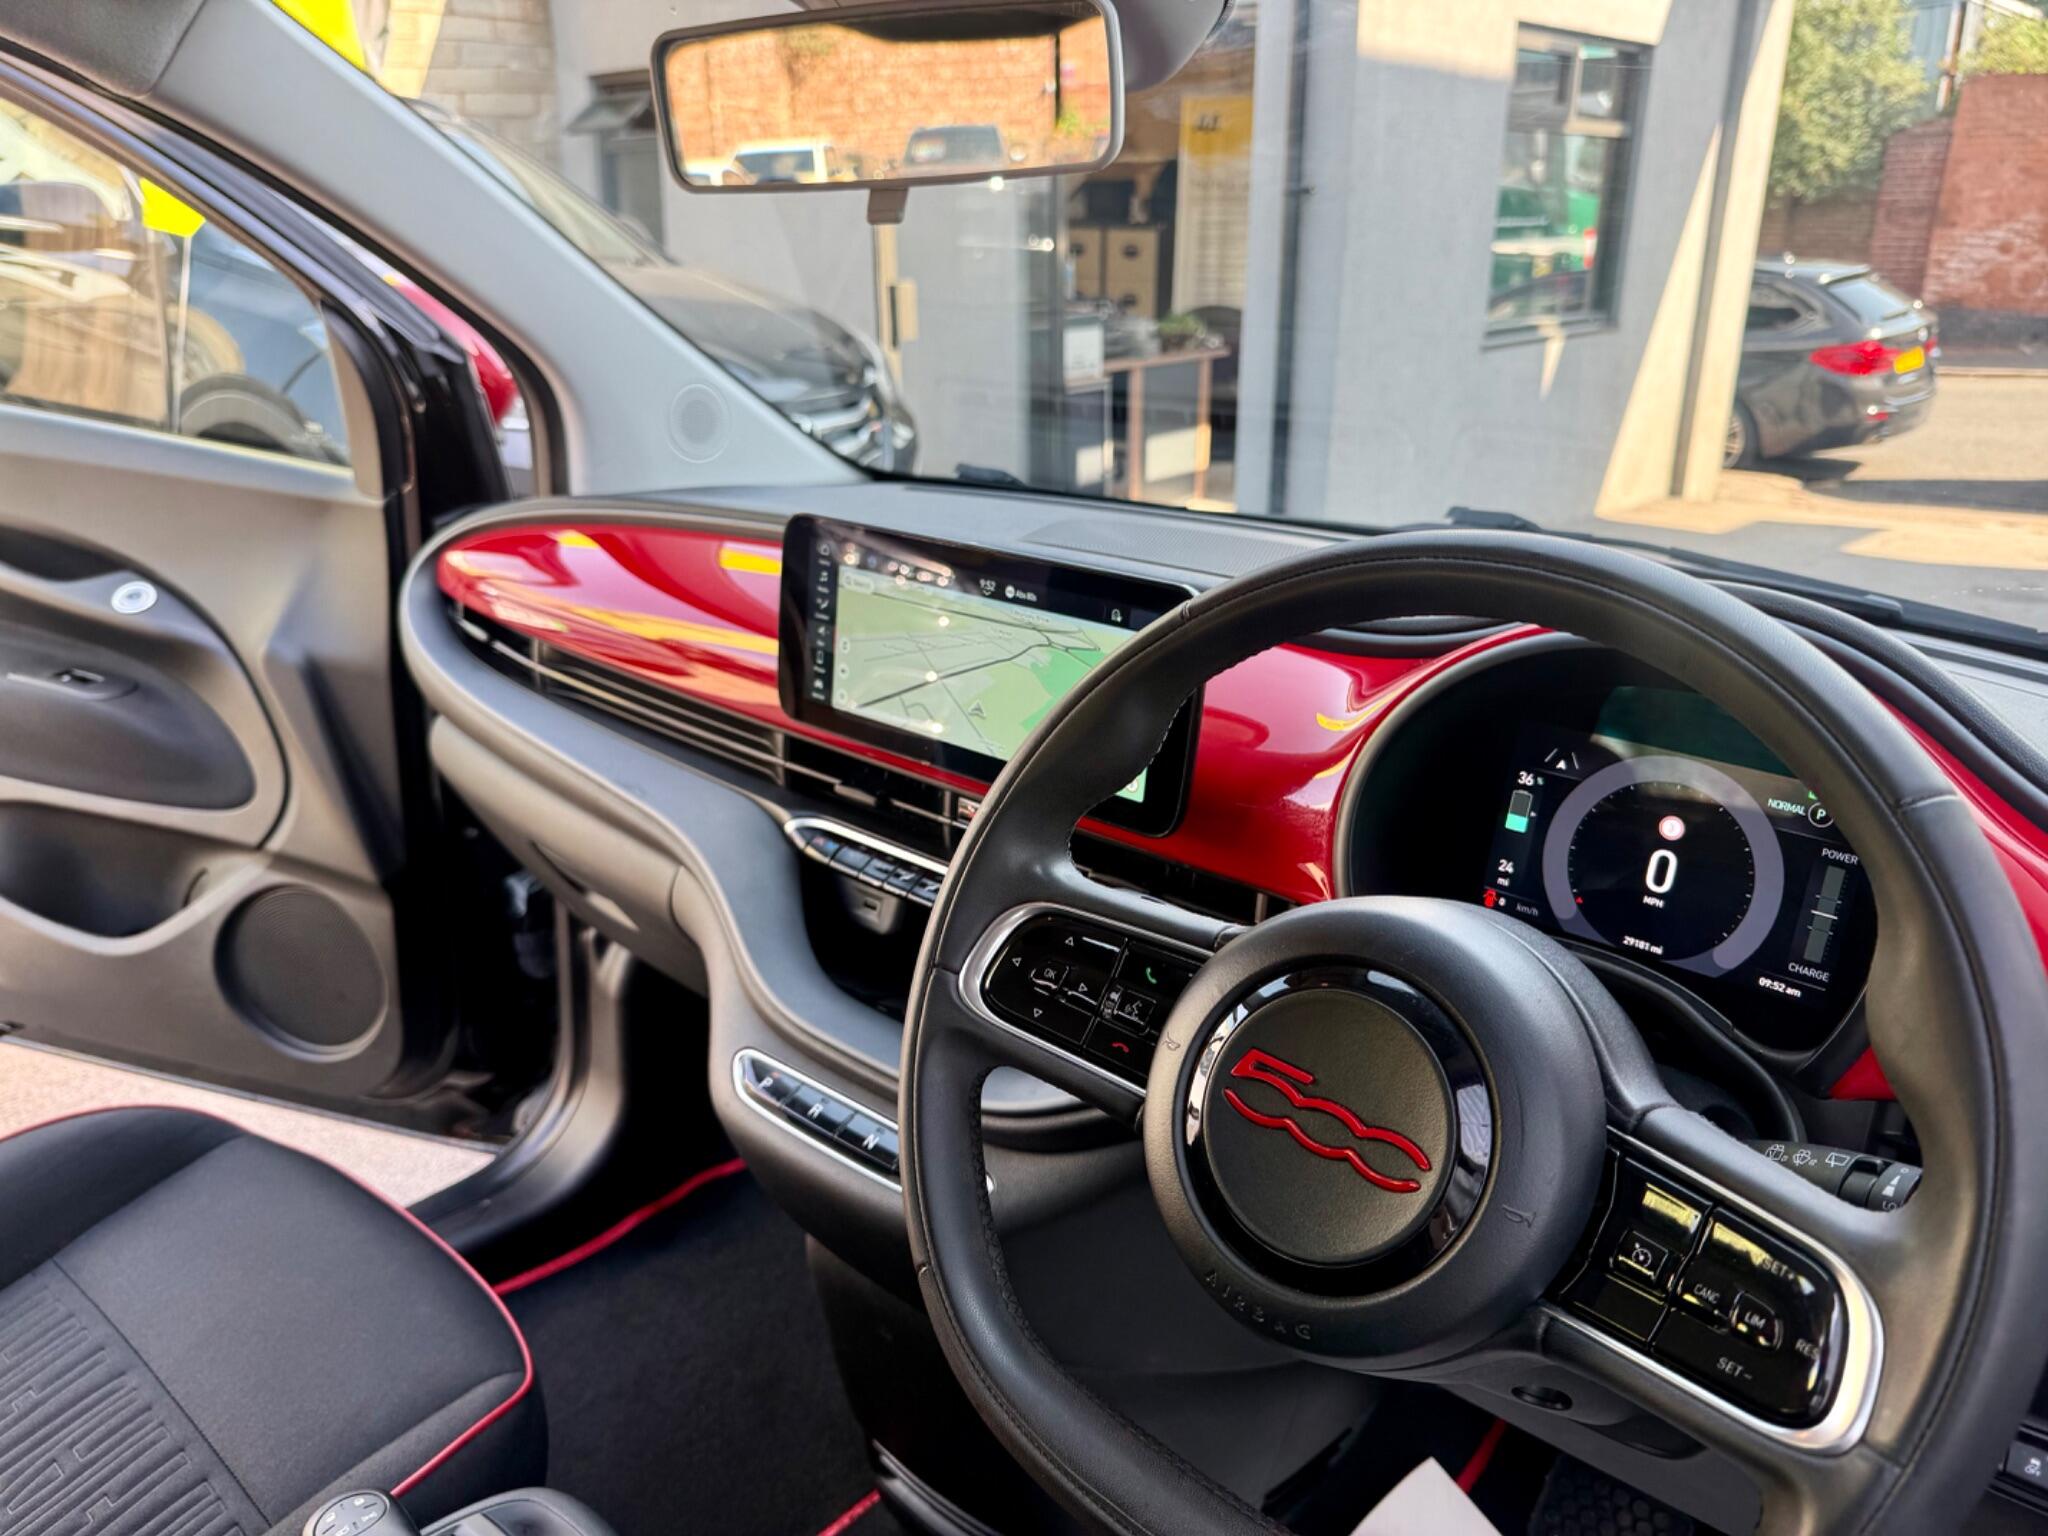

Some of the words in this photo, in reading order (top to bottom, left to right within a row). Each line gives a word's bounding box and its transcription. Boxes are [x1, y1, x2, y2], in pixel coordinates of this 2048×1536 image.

[1517, 770, 1534, 786] 36
[1767, 798, 1806, 816] NORMAL
[1816, 808, 1826, 820] P
[1821, 847, 1859, 865] POWER
[1498, 858, 1514, 874] 24
[1645, 848, 1678, 894] 0
[1642, 895, 1665, 909] MPH
[1787, 962, 1830, 983] CHARGE
[1758, 976, 1786, 993] 09:52
[1785, 986, 1802, 998] am
[757, 1077, 774, 1090] P
[806, 1103, 824, 1120] R
[1223, 1048, 1432, 1194] 500
[861, 1133, 880, 1151] N
[1693, 1283, 1720, 1304] CANC
[1744, 1311, 1766, 1329] LIM
[1795, 1338, 1820, 1360] RES
